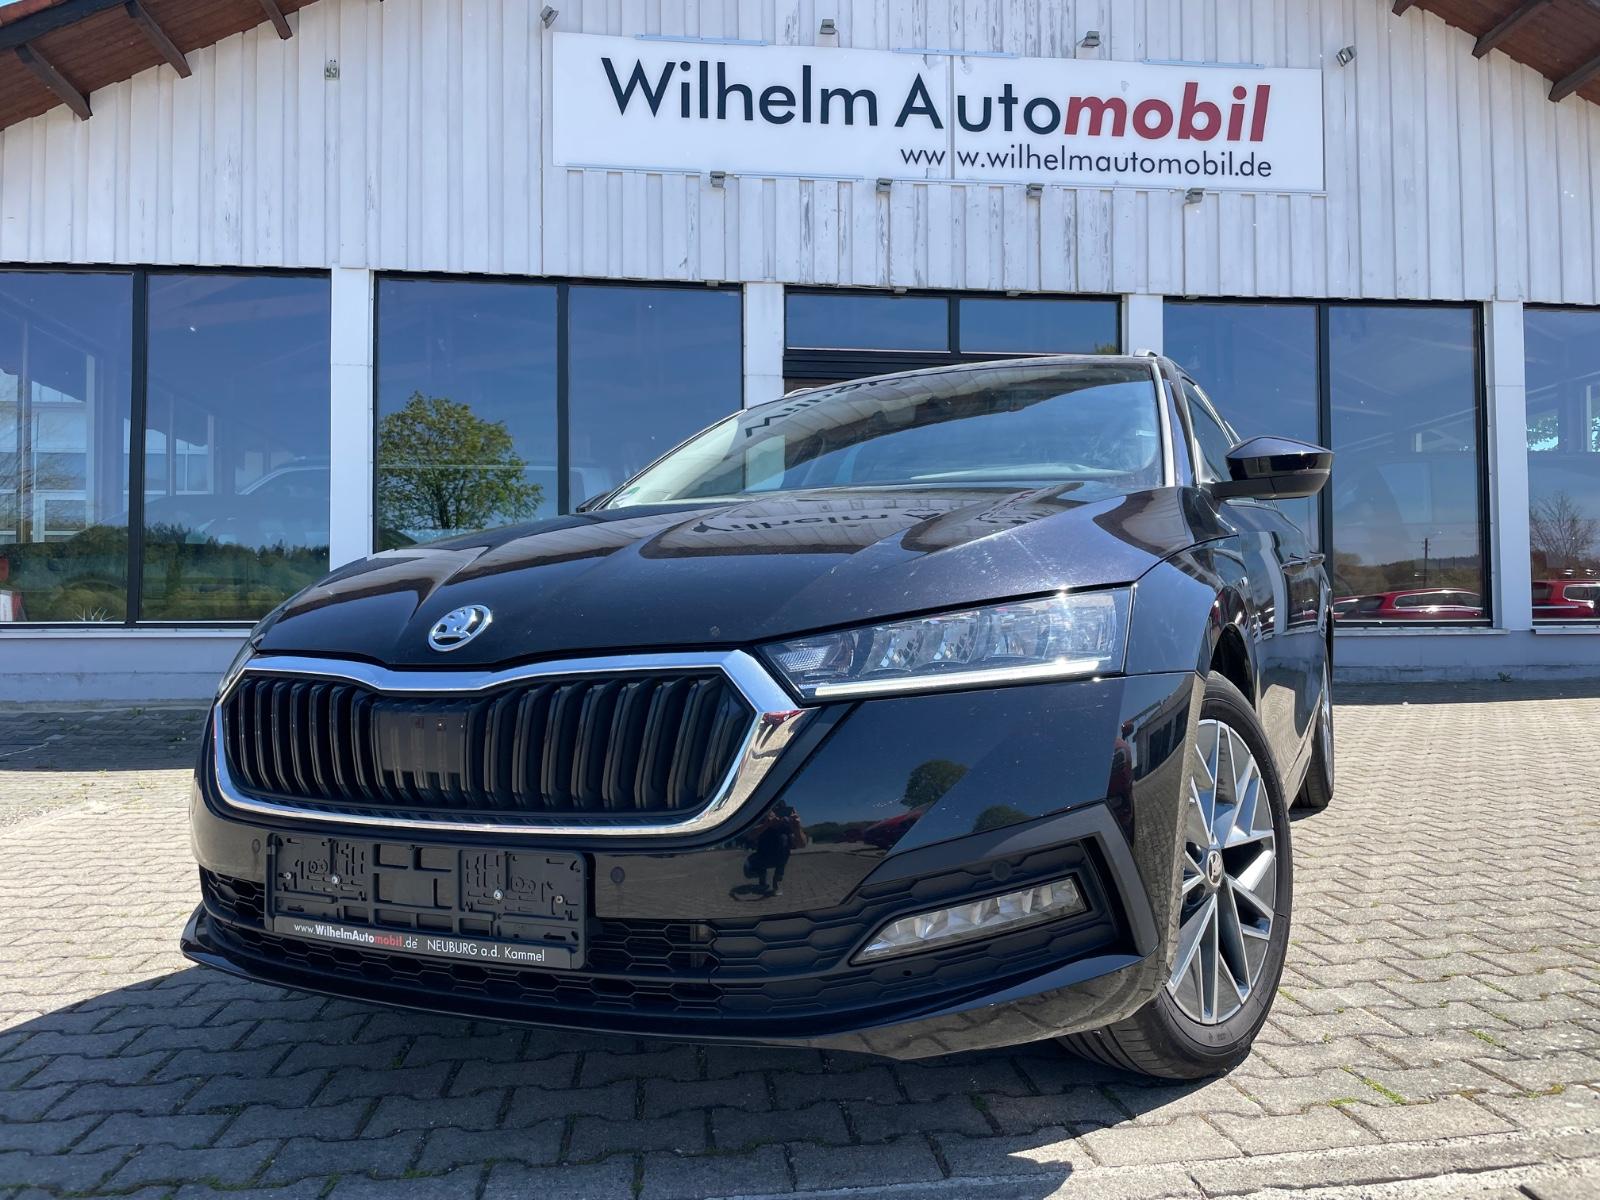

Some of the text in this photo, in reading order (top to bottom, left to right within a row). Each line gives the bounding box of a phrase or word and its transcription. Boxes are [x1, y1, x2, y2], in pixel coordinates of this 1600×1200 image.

[600, 57, 1272, 142] Wilhelm Automobil
[900, 143, 1272, 178] www.wilhelmautomobil.de
[293, 923, 545, 962] www.WilhelmAutomobil.de NEUBURG a.d. Kammel
